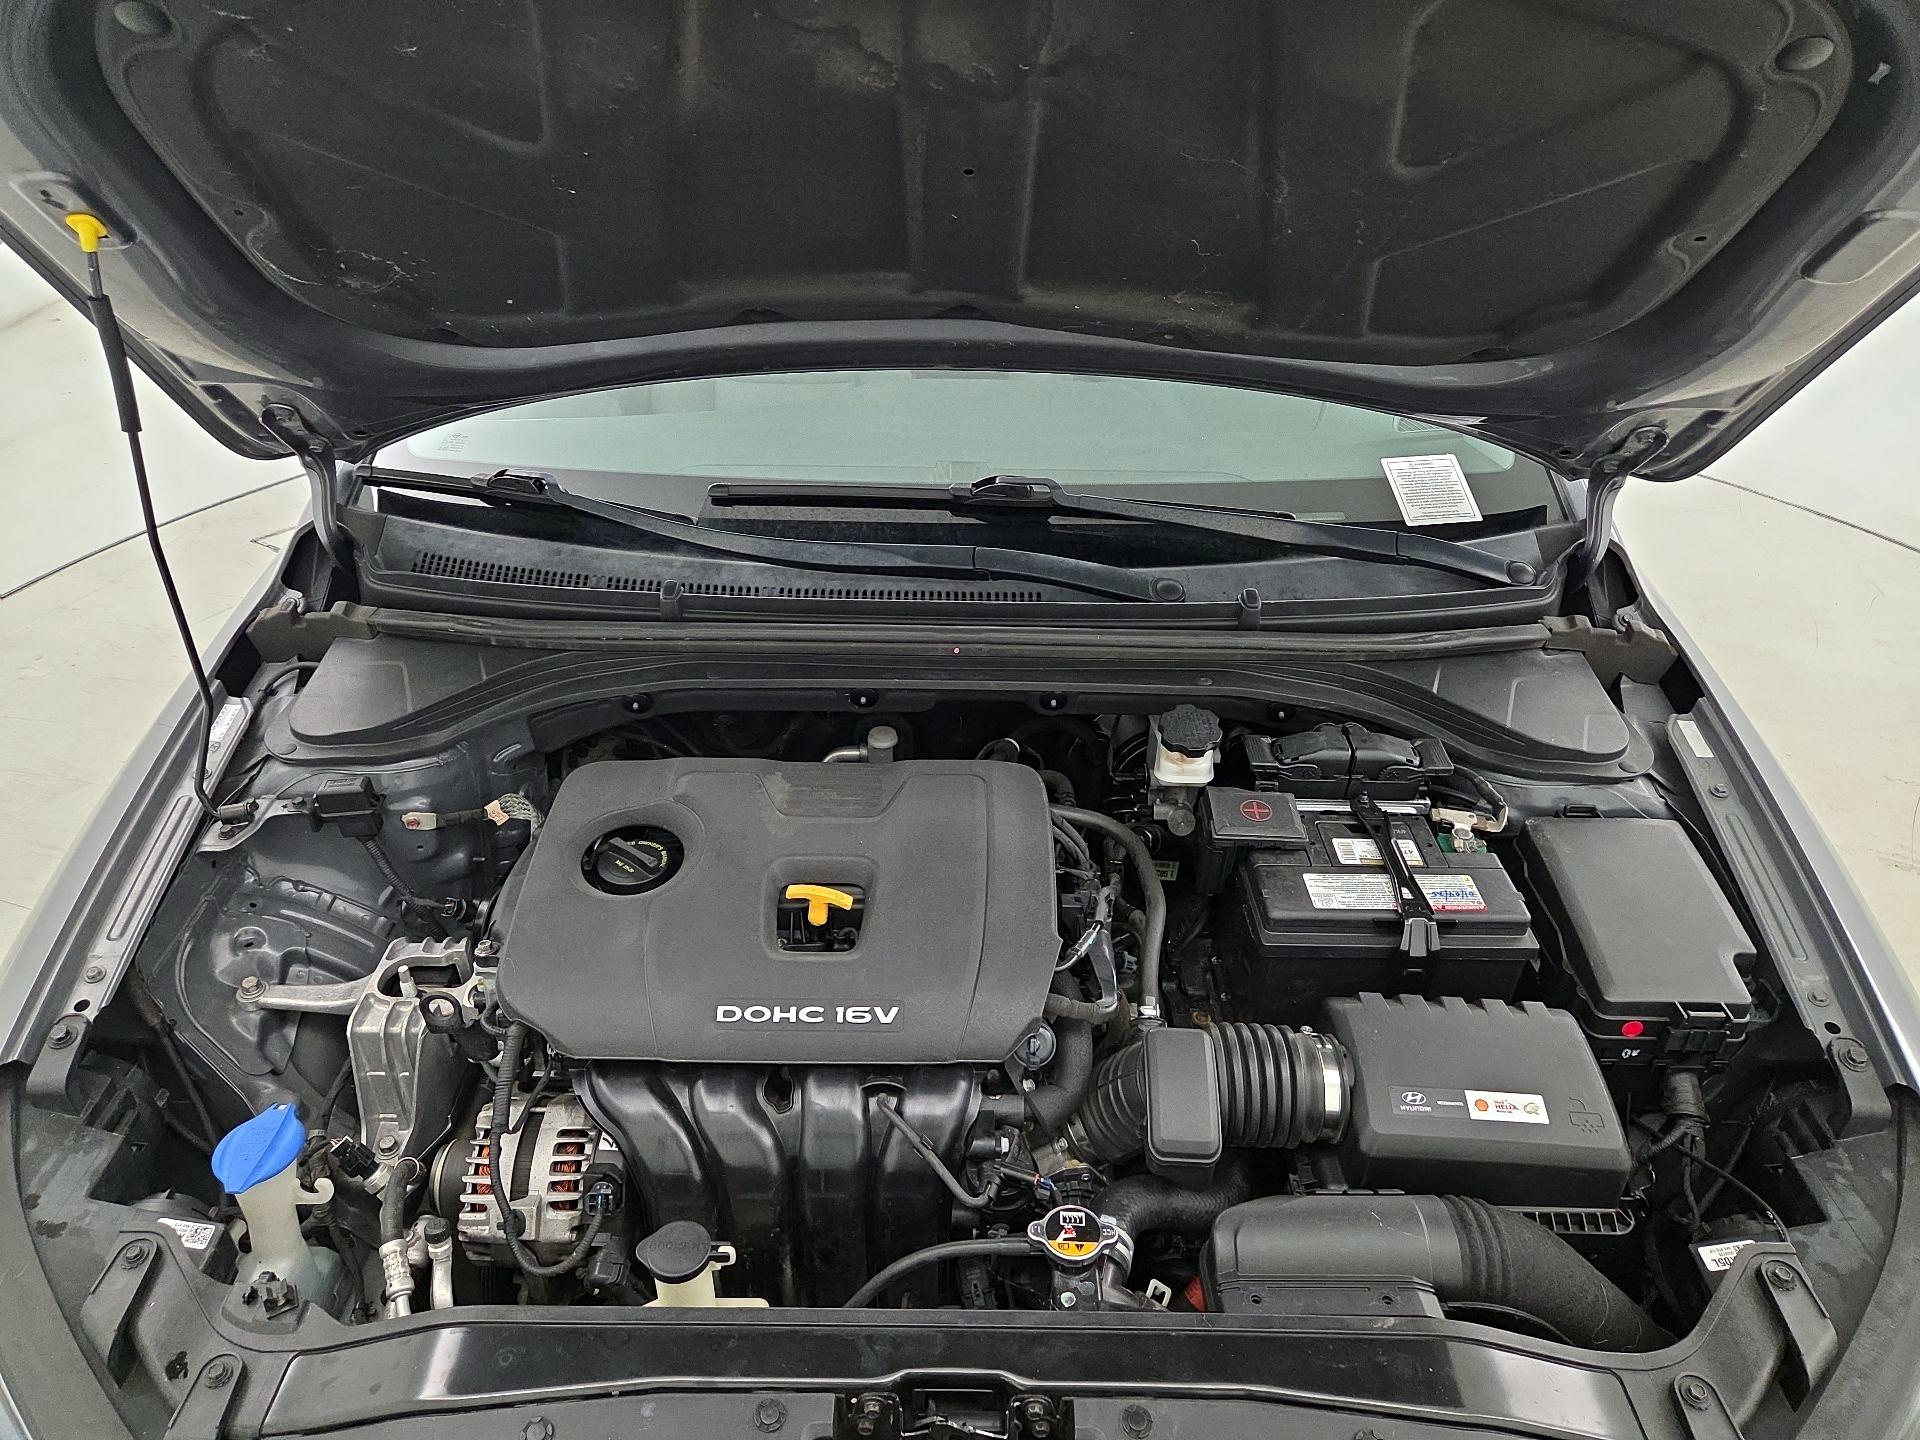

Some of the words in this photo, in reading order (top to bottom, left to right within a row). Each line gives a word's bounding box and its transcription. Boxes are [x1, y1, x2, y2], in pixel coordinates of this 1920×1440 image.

[716, 1005, 825, 1023] DOHC
[835, 1006, 900, 1024] 16V
[1400, 1104, 1432, 1112] HYUNDAI
